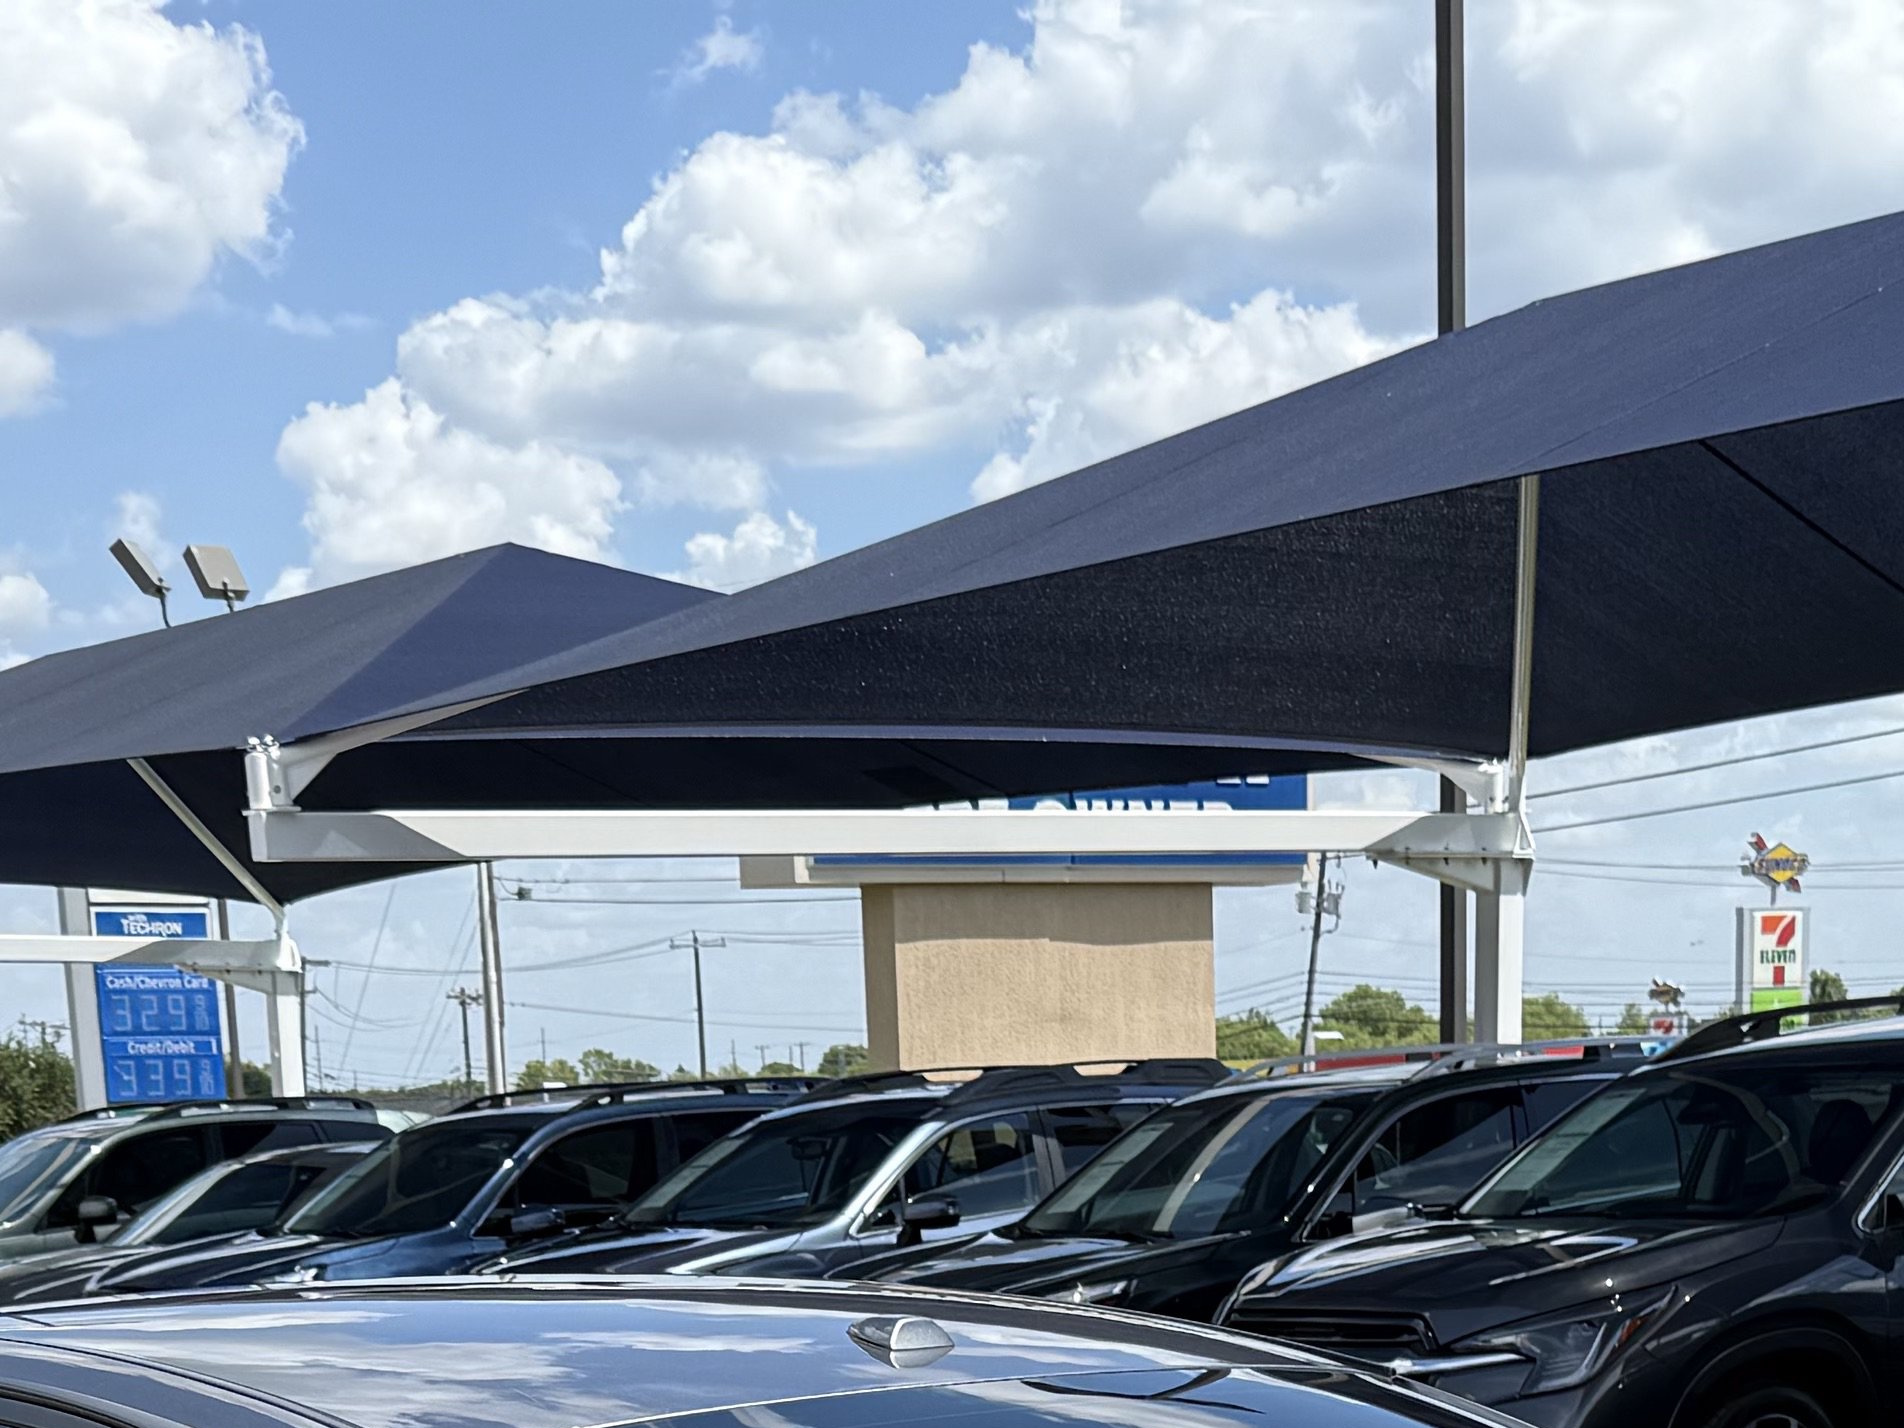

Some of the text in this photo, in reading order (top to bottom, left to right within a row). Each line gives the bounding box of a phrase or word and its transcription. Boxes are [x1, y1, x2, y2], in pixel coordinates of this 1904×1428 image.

[120, 919, 182, 937] TECHRON
[106, 976, 181, 989] Cash/Chevron
[128, 1042, 195, 1055] Credit/Debit
